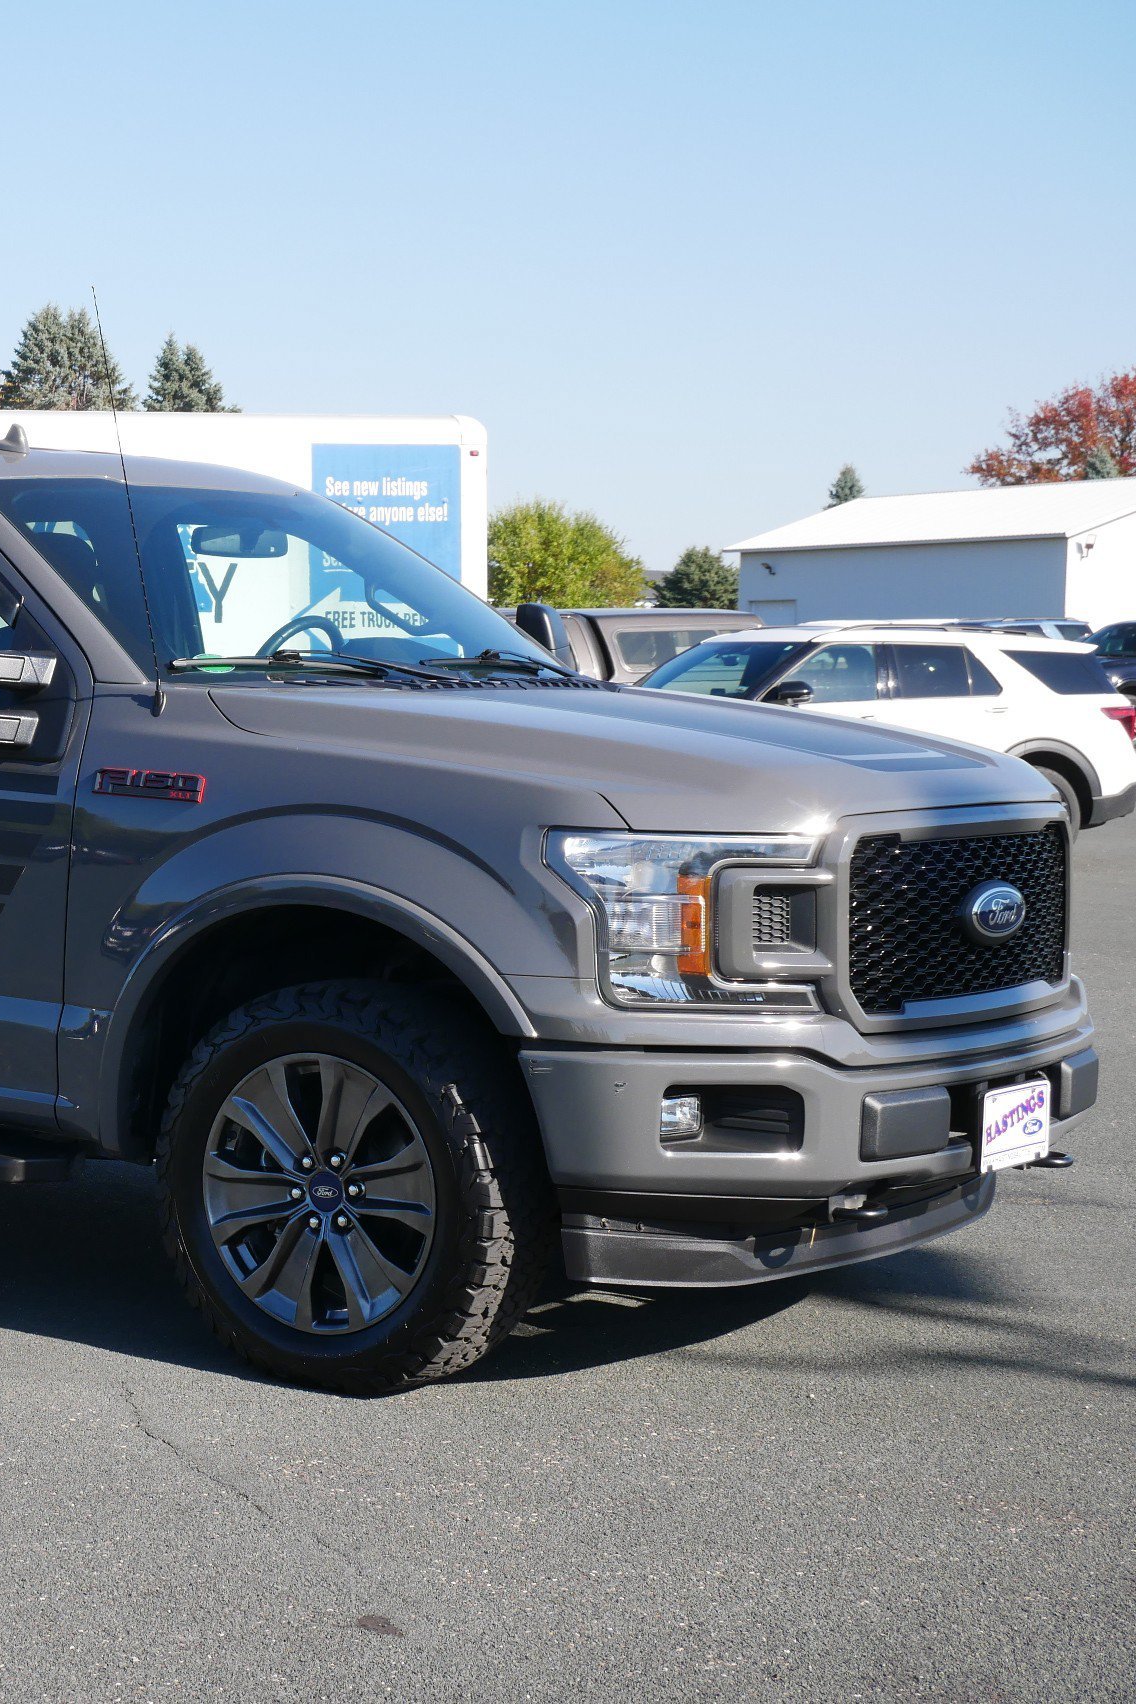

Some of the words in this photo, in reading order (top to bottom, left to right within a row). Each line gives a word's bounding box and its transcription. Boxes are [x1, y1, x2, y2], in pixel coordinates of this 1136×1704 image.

[325, 476, 350, 496] See
[353, 480, 379, 496] new
[382, 477, 428, 500] listings
[369, 505, 414, 526] anyone
[417, 503, 448, 522] else!
[989, 898, 1017, 926] Ford
[986, 1090, 1044, 1146] HASTINGS
[316, 1187, 333, 1197] Ford
